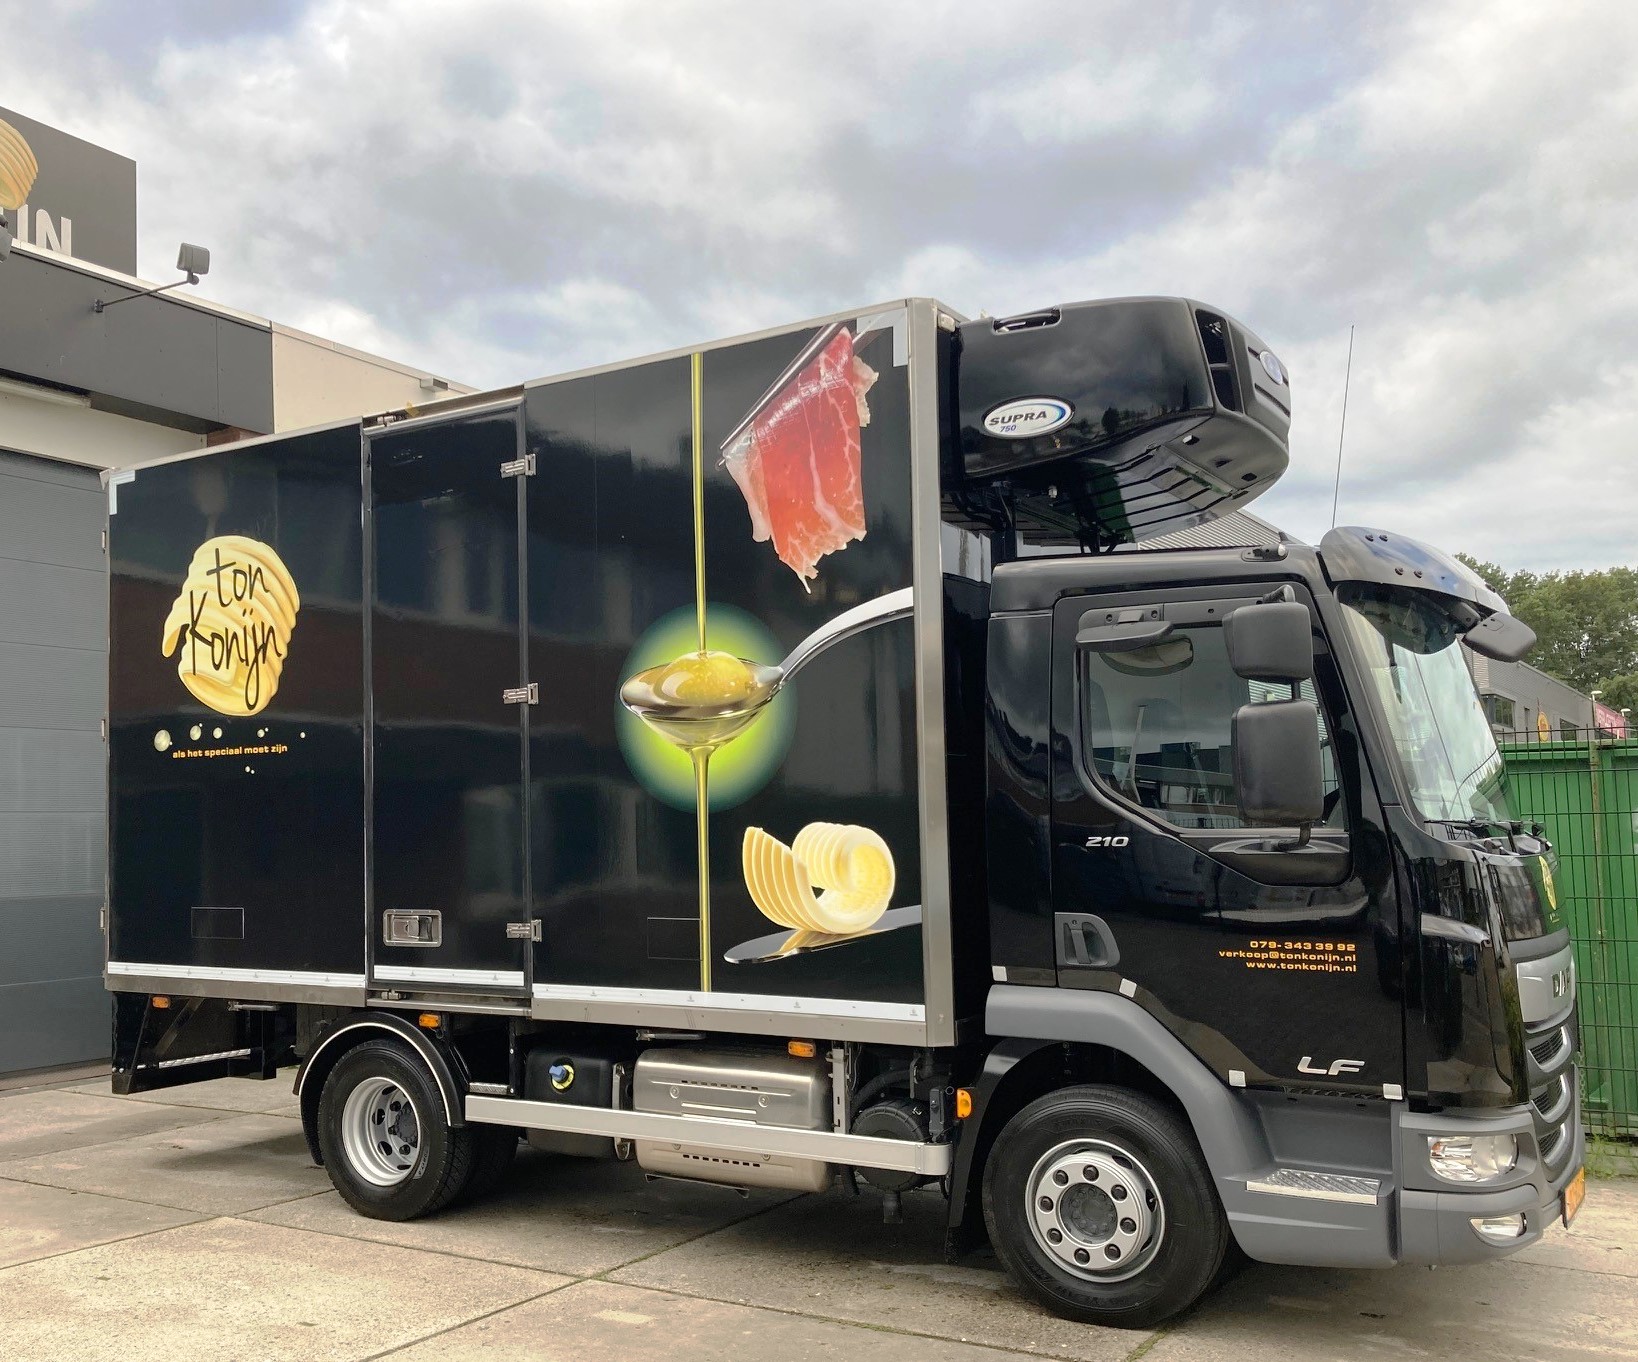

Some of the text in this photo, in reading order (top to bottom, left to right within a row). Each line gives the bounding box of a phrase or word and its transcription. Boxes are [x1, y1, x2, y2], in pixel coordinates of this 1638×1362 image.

[989, 411, 1047, 426] SUPRA
[1000, 424, 1017, 433] 750
[207, 548, 270, 607] ton
[172, 743, 288, 759] als het speciaal moet zijn
[1085, 836, 1129, 847] 210
[1284, 942, 1312, 950] 343
[1218, 950, 1357, 962] verkoop@tonkonijn.nl
[1246, 962, 1357, 973] www.tonkonijn.nl
[1297, 1056, 1366, 1076] LF
